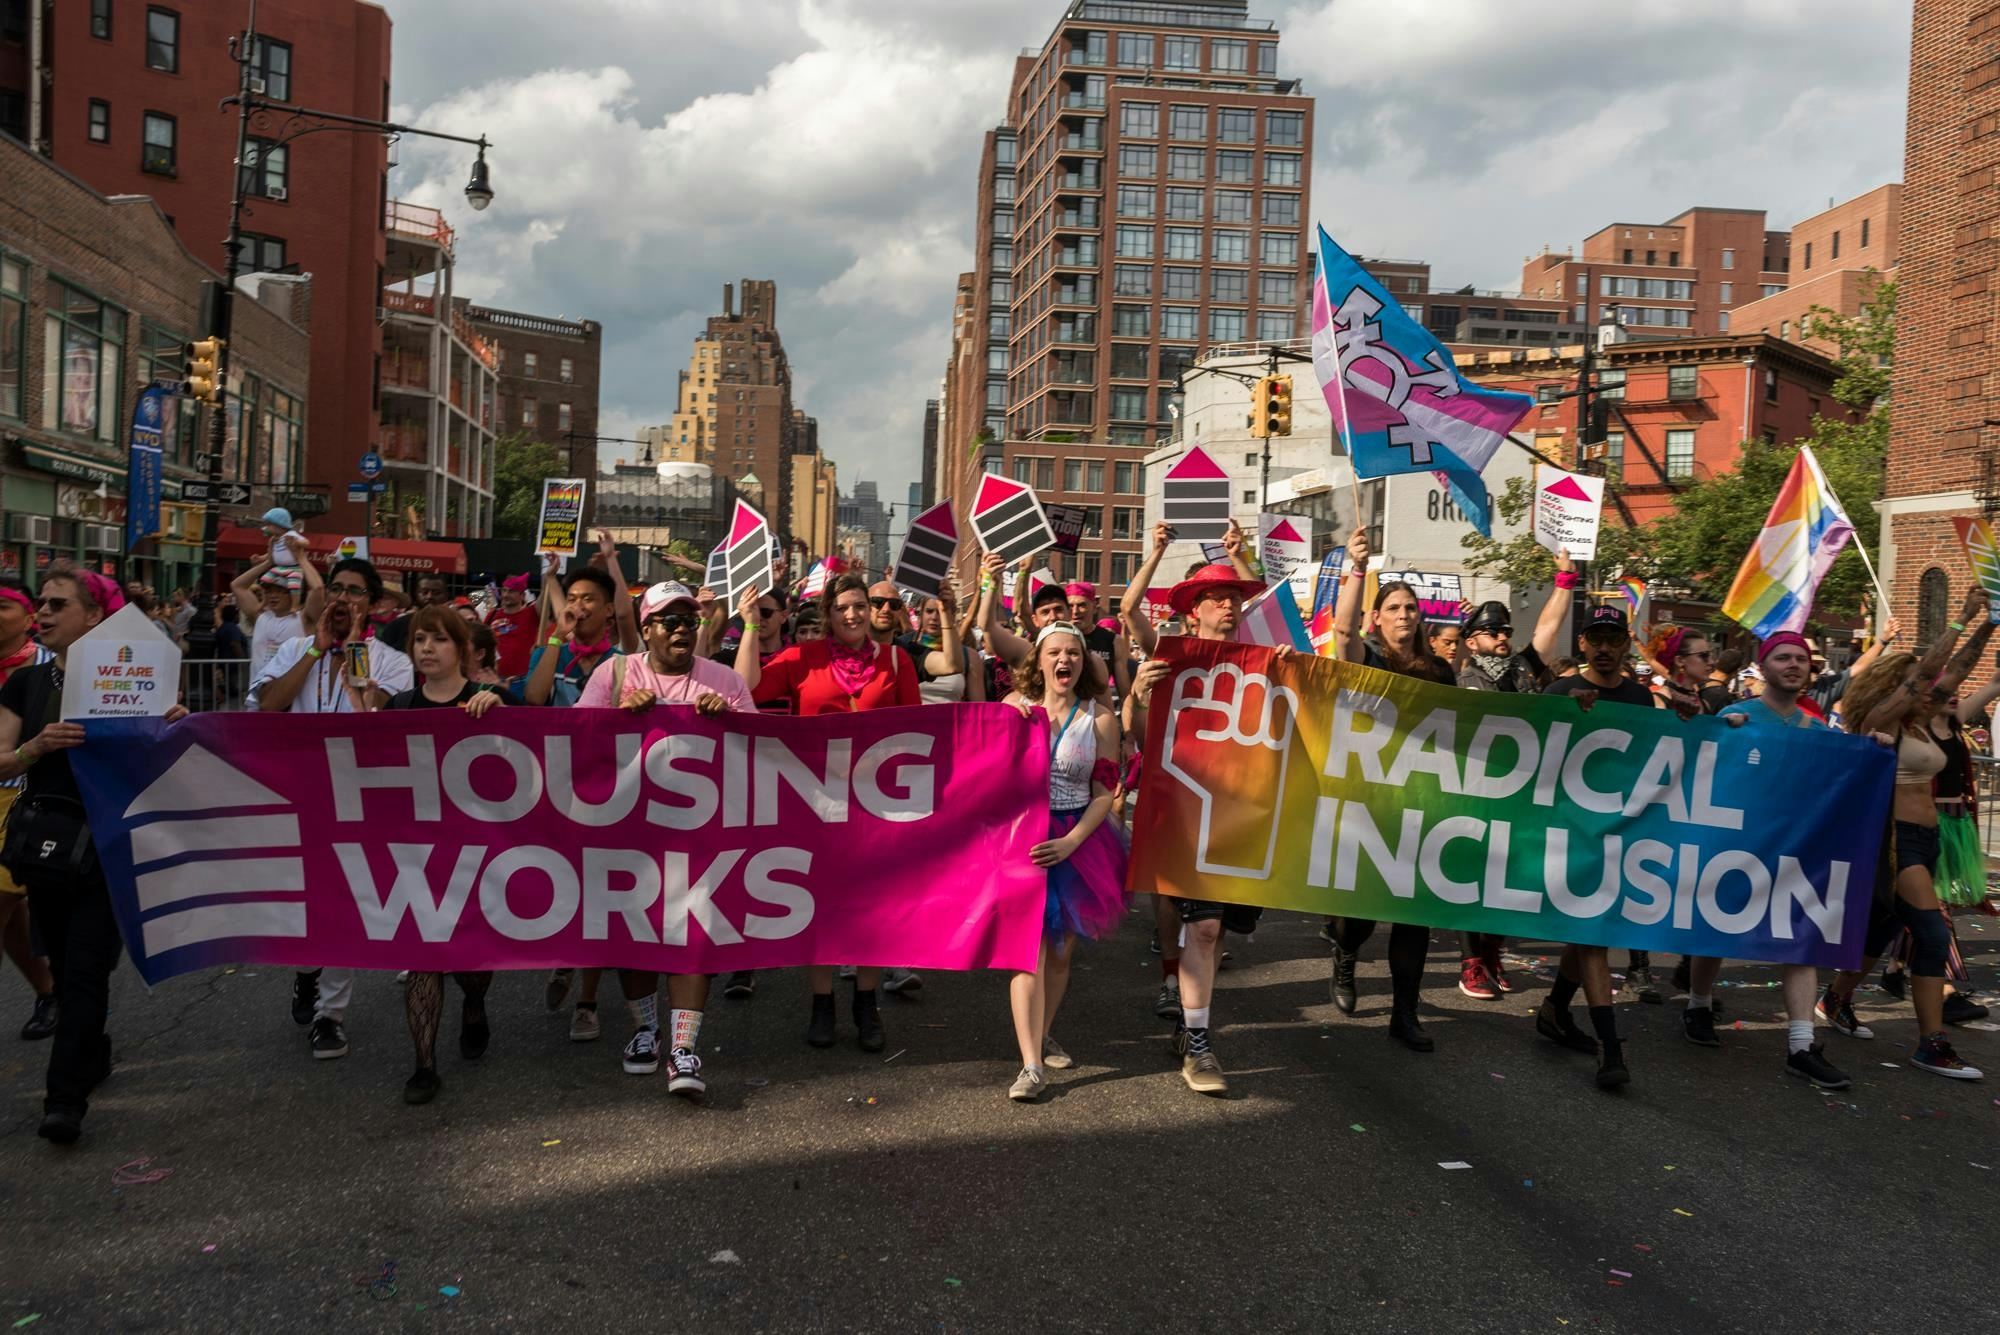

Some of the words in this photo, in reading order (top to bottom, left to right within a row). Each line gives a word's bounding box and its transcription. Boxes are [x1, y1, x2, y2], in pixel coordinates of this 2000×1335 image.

[1046, 505, 1085, 525] FE
[1558, 513, 1594, 524] FIGHTING
[1556, 528, 1574, 536] AND
[370, 555, 434, 569] ANGUARD
[1379, 572, 1460, 588] SAFE
[1594, 608, 1620, 619] U=U
[97, 666, 122, 676] WE
[125, 667, 154, 677] ARE
[93, 680, 132, 690] HERE
[134, 681, 155, 691] TO
[102, 694, 144, 704] STAY.
[89, 709, 149, 717] #LoveNotHate
[1325, 688, 1743, 829] RADICAL
[326, 733, 934, 829] HOUSING
[1307, 797, 1850, 944] INCLUSION
[334, 843, 814, 945] WORKS
